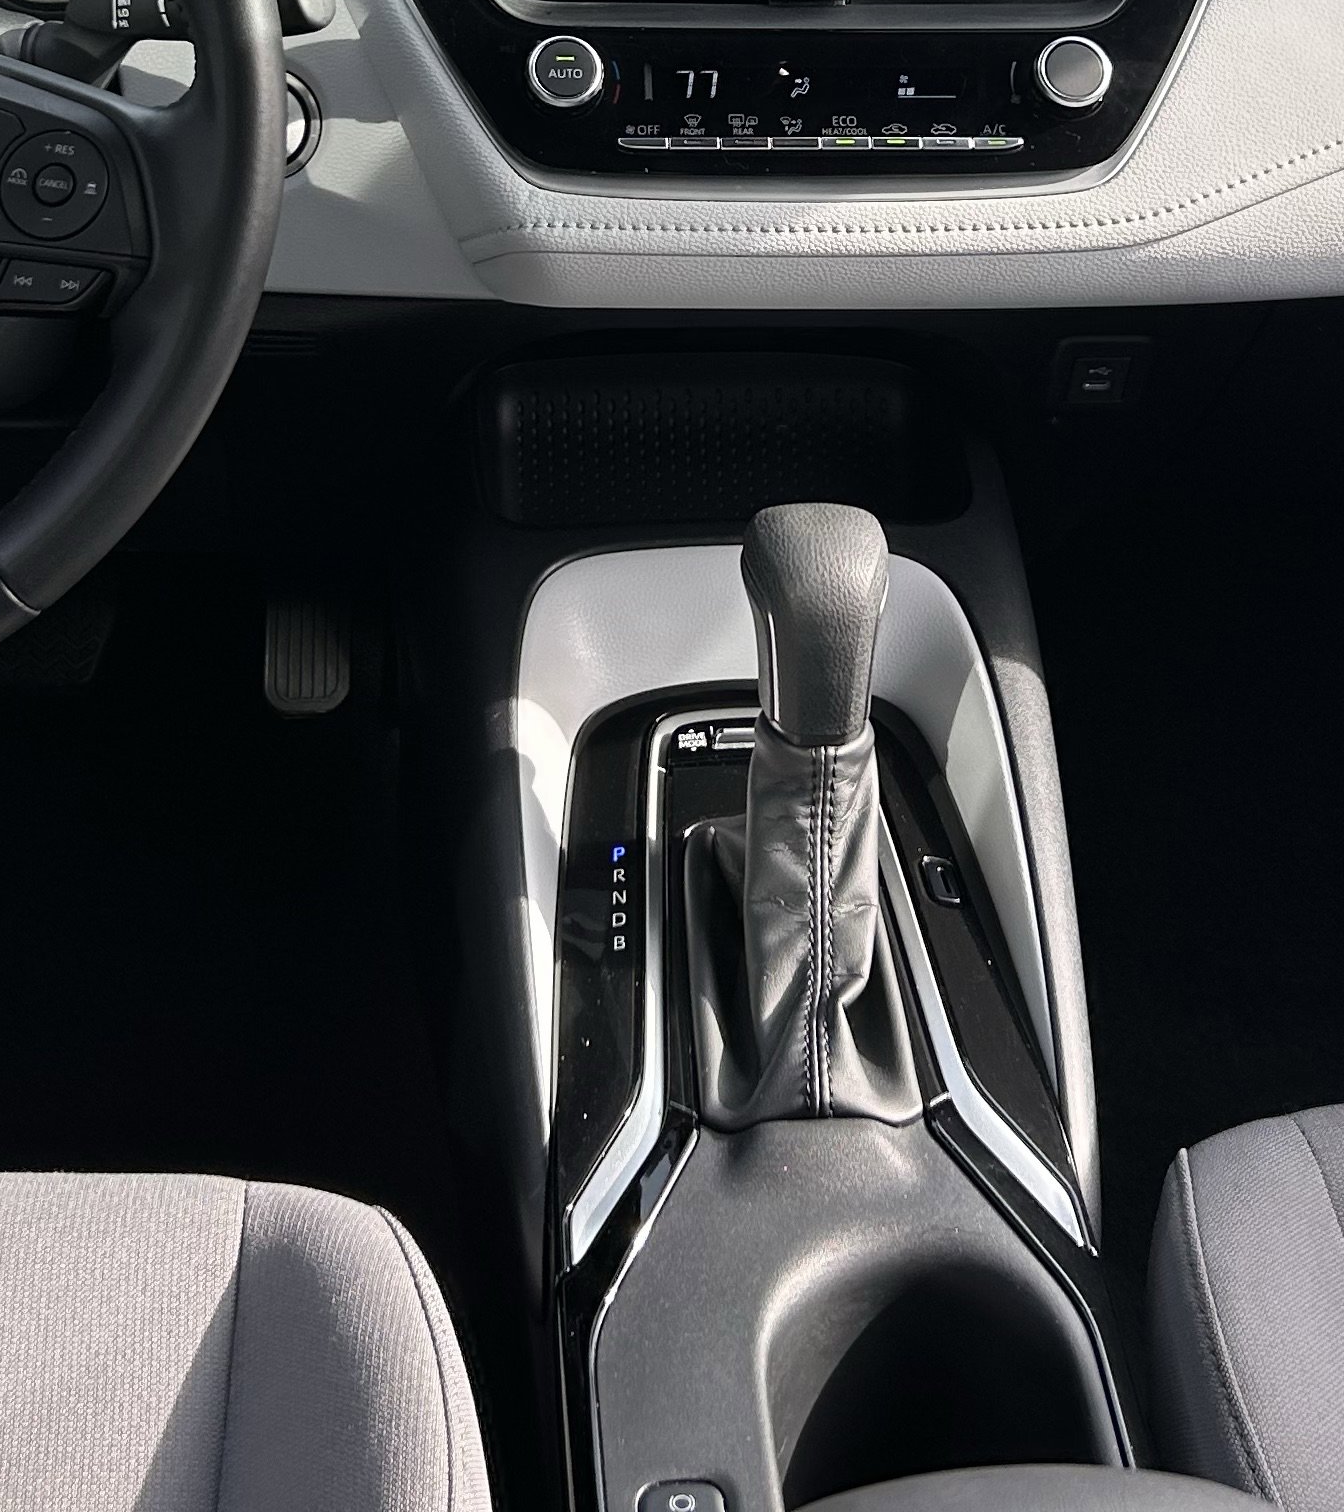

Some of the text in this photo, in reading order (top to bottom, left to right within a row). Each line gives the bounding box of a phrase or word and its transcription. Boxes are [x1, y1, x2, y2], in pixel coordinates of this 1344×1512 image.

[117, 8, 130, 17] LO
[118, 19, 130, 28] HI
[548, 68, 583, 80] AUTO
[676, 70, 719, 99] 77
[832, 115, 857, 126] ECO
[637, 125, 661, 135] OFF
[680, 128, 706, 136] FRONT
[732, 128, 754, 136] REAR
[822, 128, 868, 136] HEAT/COOL
[983, 124, 1007, 135] A/C
[55, 144, 76, 155] RES
[38, 177, 68, 190] CANCEL
[678, 731, 706, 740] DRIVE
[678, 740, 707, 749] MODE
[612, 846, 627, 862] P
[612, 868, 627, 883] R
[612, 889, 627, 906] N
[612, 912, 627, 928] D
[612, 935, 627, 951] B
